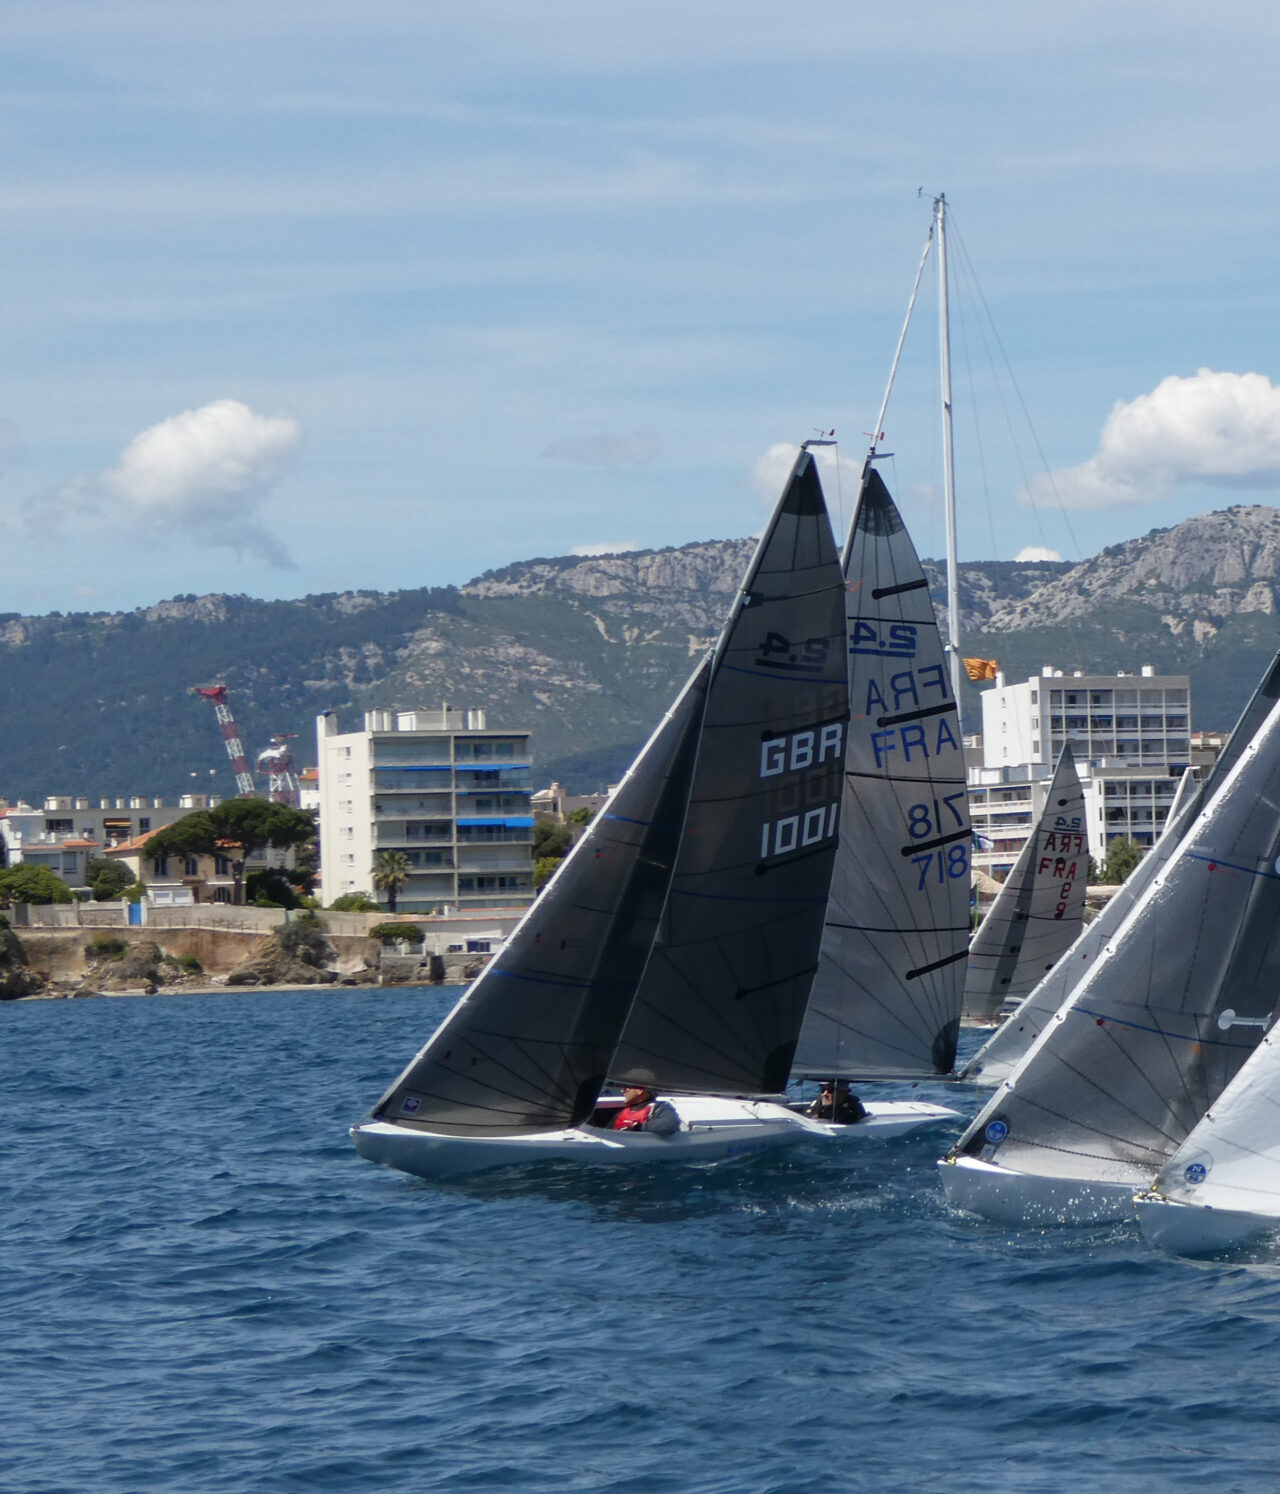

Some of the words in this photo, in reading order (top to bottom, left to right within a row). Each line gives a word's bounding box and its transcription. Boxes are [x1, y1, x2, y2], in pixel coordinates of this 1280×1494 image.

[759, 723, 843, 778] GBR
[870, 718, 959, 768] FRA
[761, 802, 838, 858] 1001
[911, 844, 968, 891] 718
[1038, 857, 1077, 880] FRA
